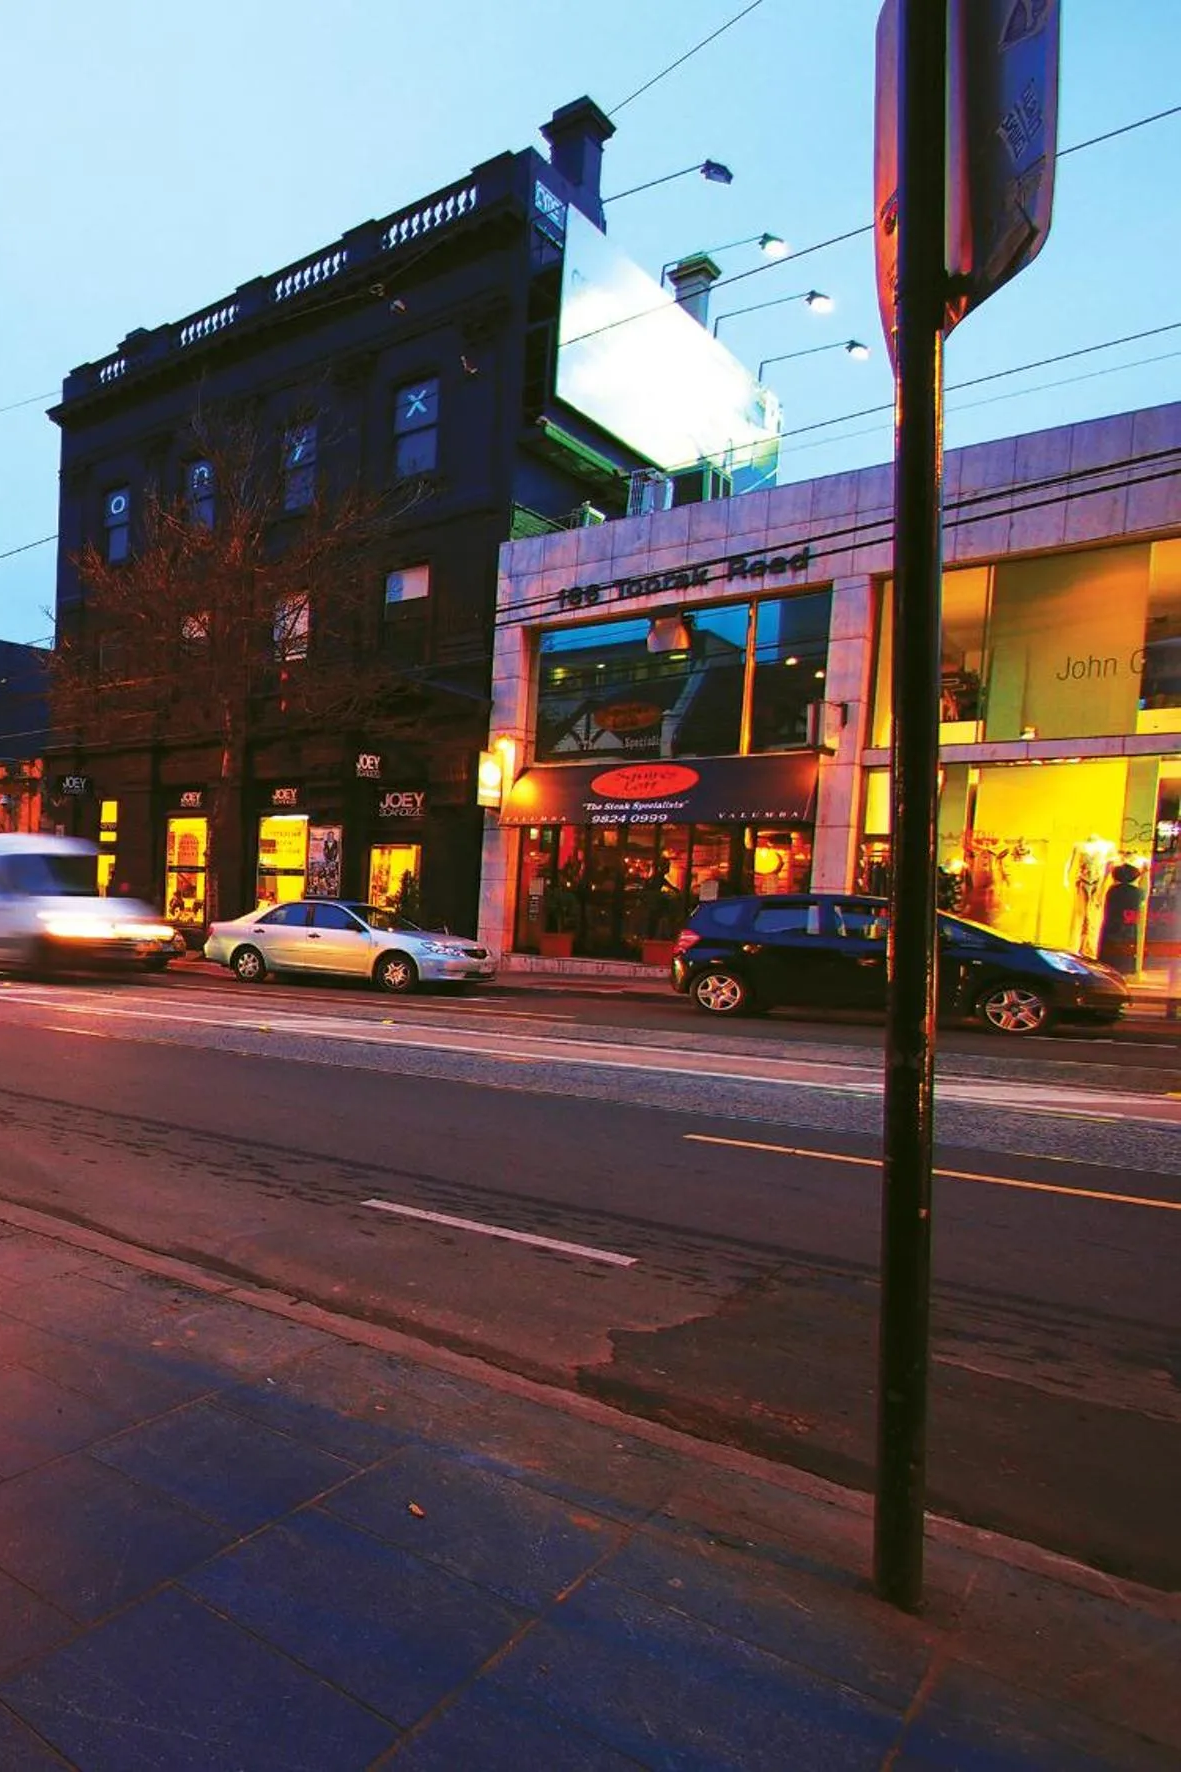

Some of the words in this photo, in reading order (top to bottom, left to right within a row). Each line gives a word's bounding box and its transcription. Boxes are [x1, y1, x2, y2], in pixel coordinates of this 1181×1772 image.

[616, 567, 709, 598] Toorak
[727, 547, 810, 582] Road
[1056, 655, 1117, 680] John
[356, 754, 380, 769] JOEY
[62, 776, 86, 789] JOEY
[272, 788, 297, 801] JOEY
[380, 791, 425, 808] JOEY
[604, 801, 630, 810] Steak
[591, 813, 626, 823] 9824
[630, 813, 668, 823] 0999
